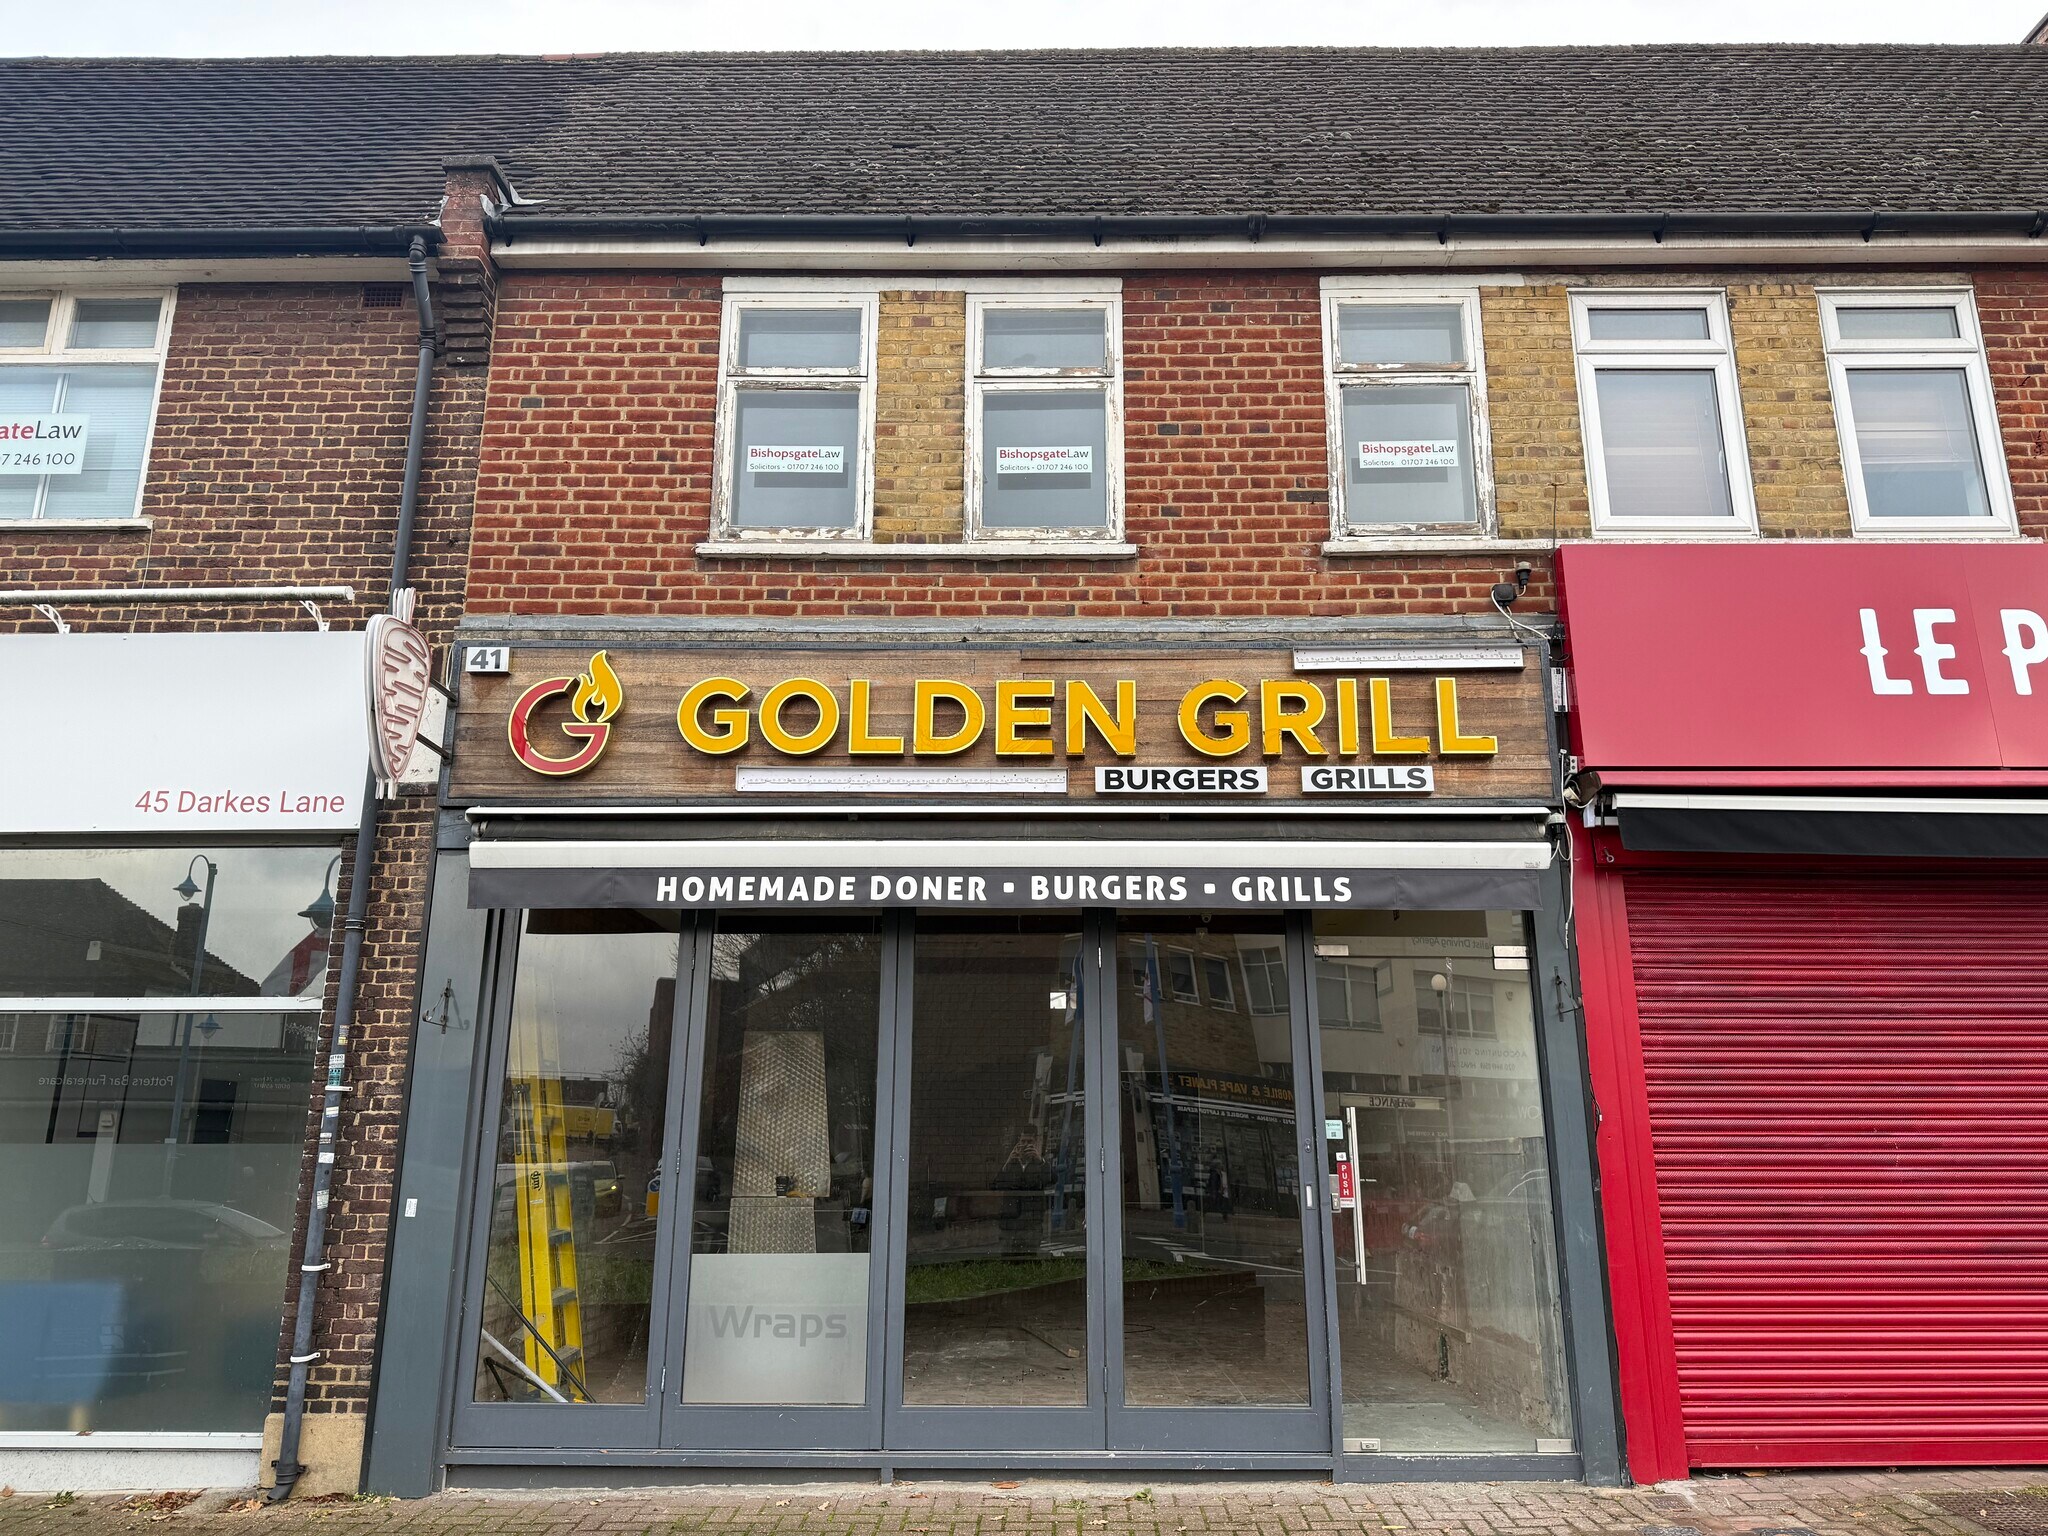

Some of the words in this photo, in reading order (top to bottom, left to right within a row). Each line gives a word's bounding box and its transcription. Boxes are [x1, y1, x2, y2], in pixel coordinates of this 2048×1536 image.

[14, 453, 41, 465] 246
[46, 452, 75, 465] 100
[750, 447, 841, 461] BishopsgateLaw
[999, 448, 1089, 461] BishopsgateLaw
[1362, 443, 1455, 456] BishopsgateLaw
[470, 649, 502, 670] 41
[1858, 607, 1970, 695] LE
[677, 676, 1137, 758] GOLDEN
[1177, 676, 1499, 758] GRILL
[1104, 768, 1260, 791] BURGERS
[1310, 767, 1428, 790] GRILLS
[135, 790, 169, 813] 45
[177, 789, 271, 813] Darkes
[280, 790, 345, 813] Lane
[656, 876, 857, 902] HOMEMADE
[870, 875, 988, 902] DONER
[1031, 874, 1188, 901] BURGERS
[1231, 876, 1352, 902] GRILLS
[1341, 1164, 1350, 1196] PUSH
[709, 1304, 847, 1347] Wraps
